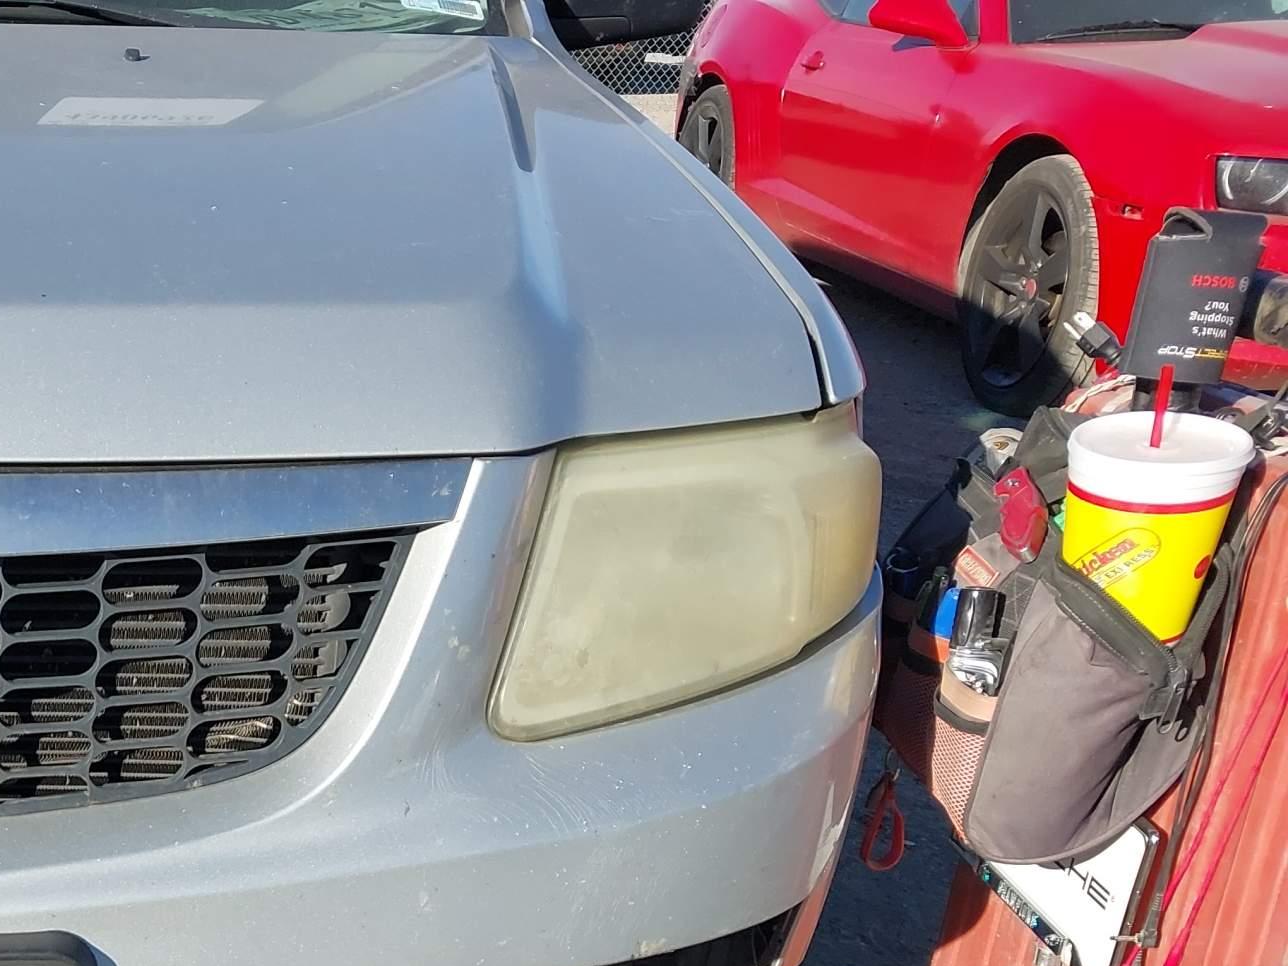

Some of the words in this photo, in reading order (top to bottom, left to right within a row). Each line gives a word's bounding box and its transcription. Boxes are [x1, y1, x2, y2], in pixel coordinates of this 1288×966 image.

[1191, 274, 1238, 289] BOSCH
[1204, 301, 1230, 312] You?
[1188, 310, 1235, 326] Stopping
[1192, 325, 1228, 339] What's
